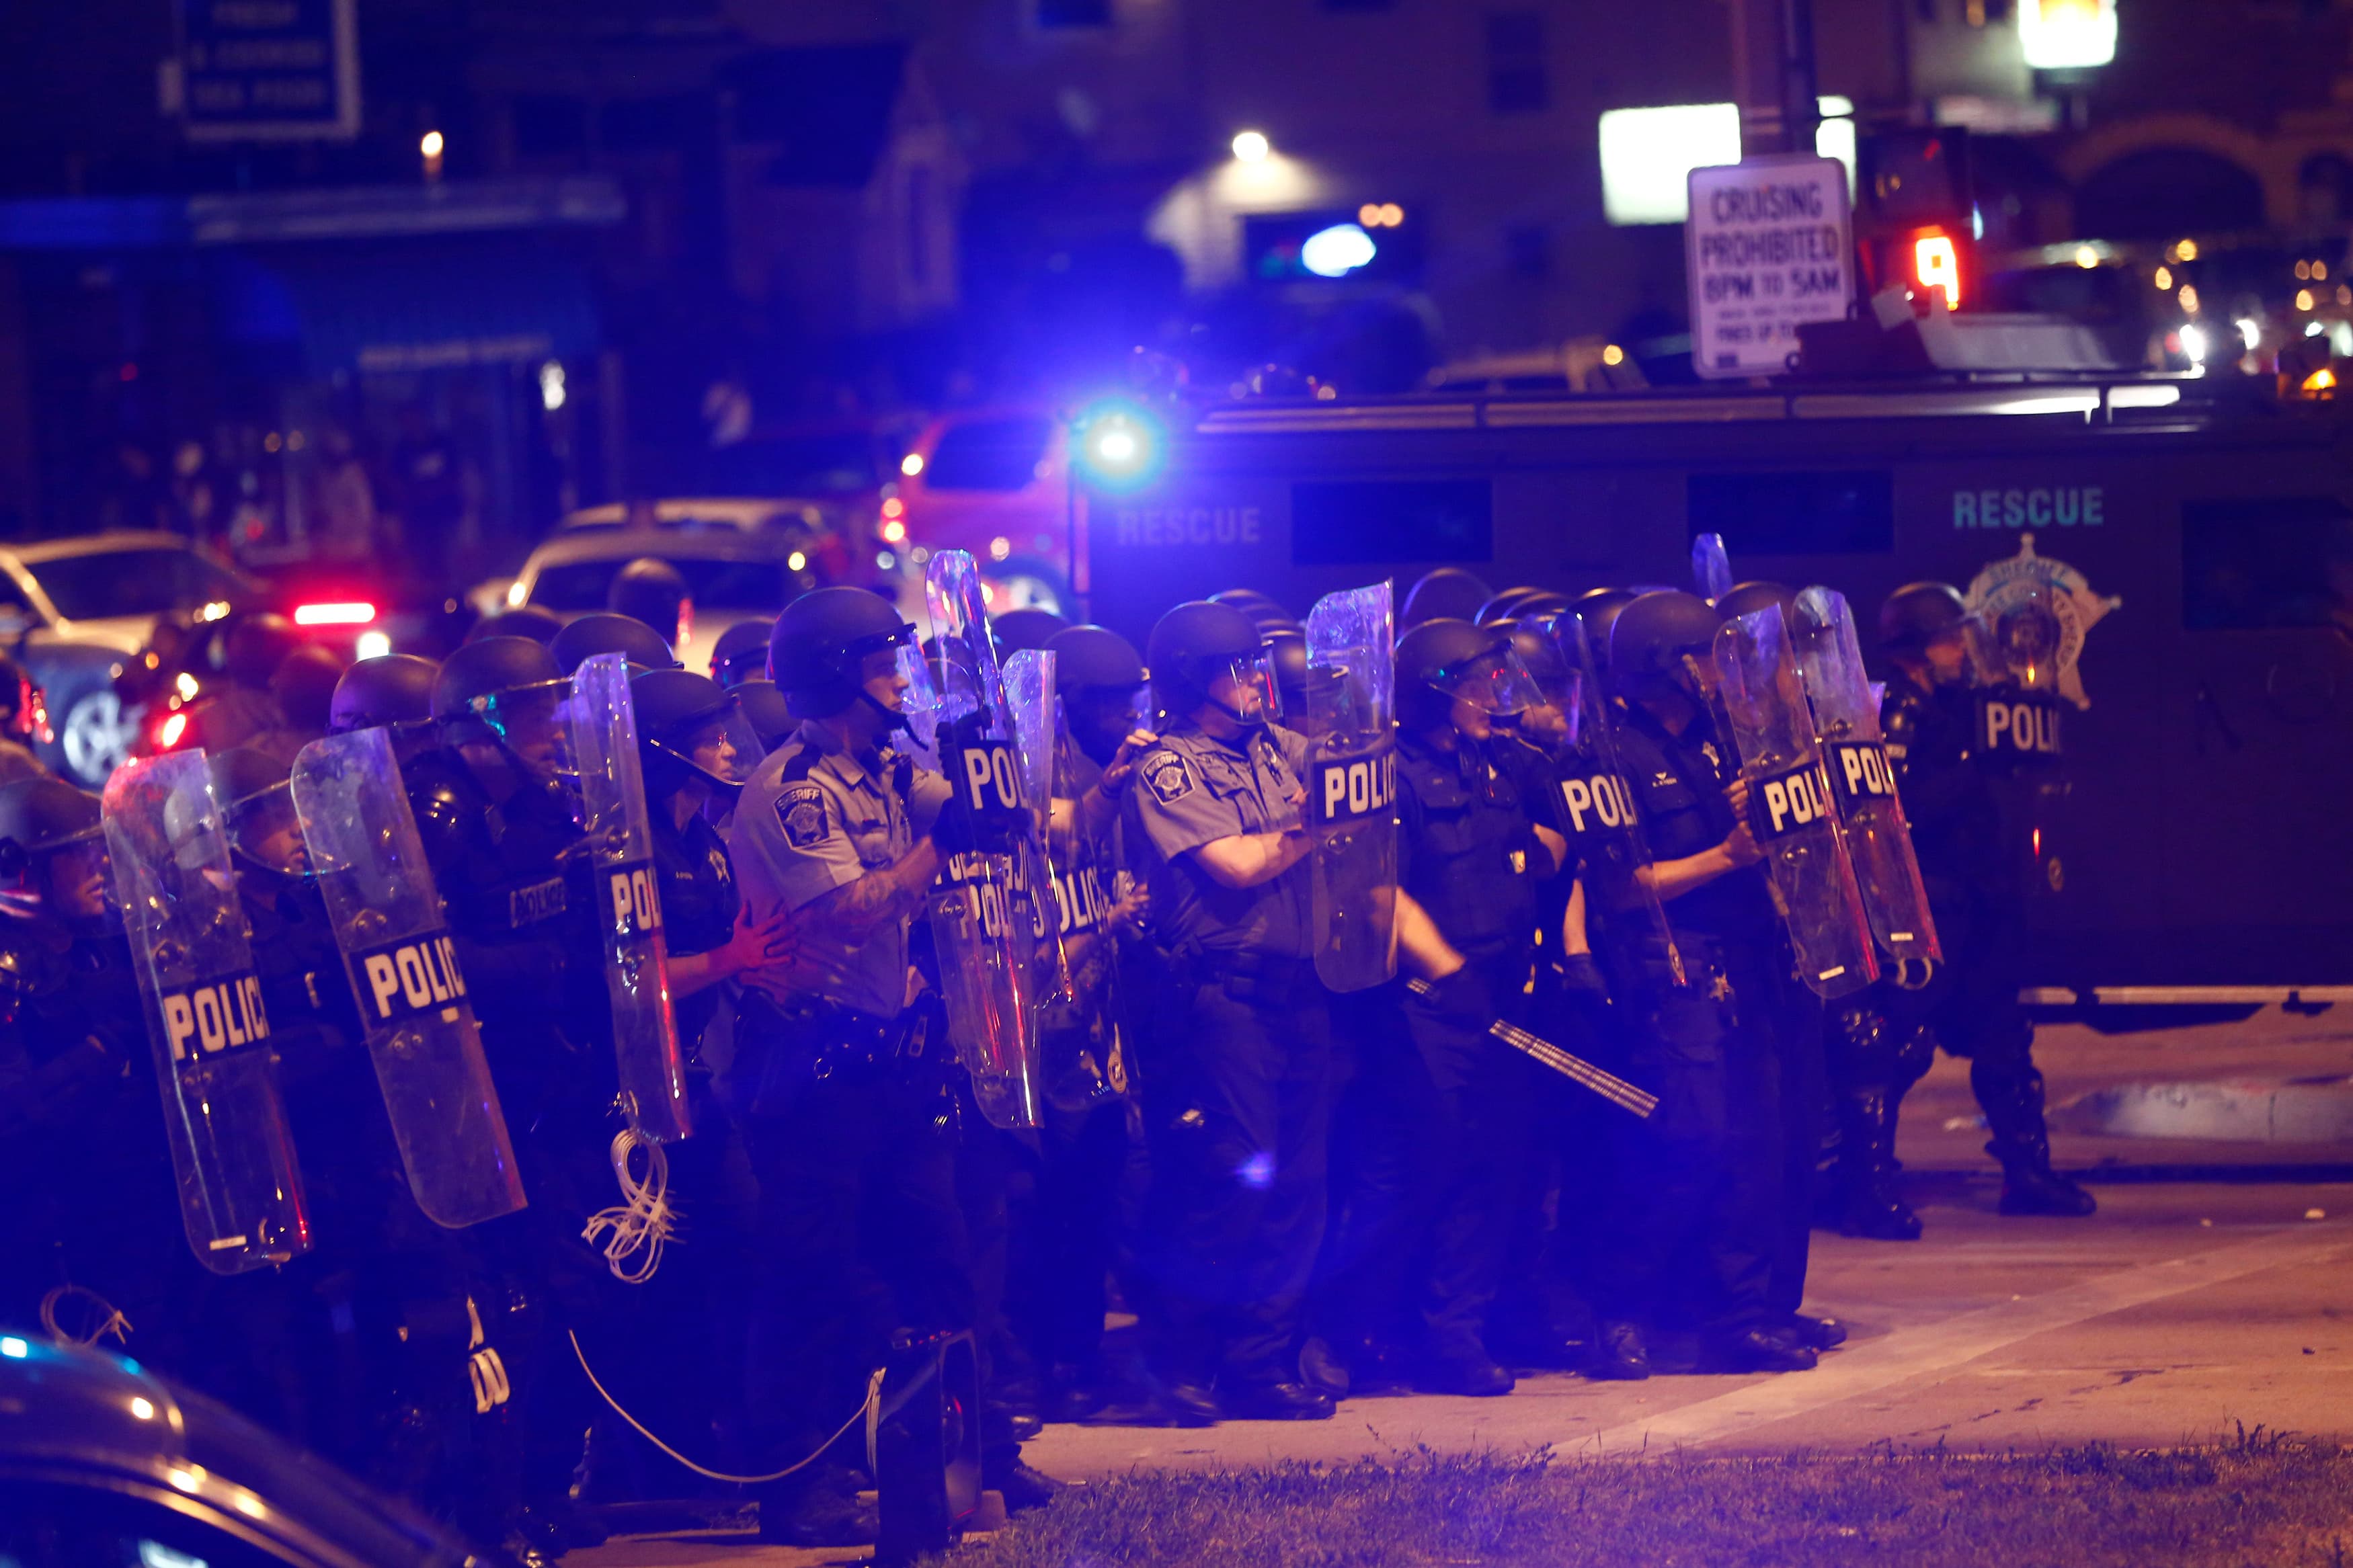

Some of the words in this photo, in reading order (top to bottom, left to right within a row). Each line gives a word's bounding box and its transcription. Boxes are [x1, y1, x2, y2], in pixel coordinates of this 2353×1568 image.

[1712, 183, 1823, 224] CRUISING
[1701, 226, 1839, 267] PROHIBITED
[1761, 272, 1784, 294] TO
[1117, 506, 1261, 545] RESCUE
[1954, 487, 2104, 528] RESCUE
[364, 936, 466, 1018] POLIC
[163, 975, 270, 1061] POLIC
